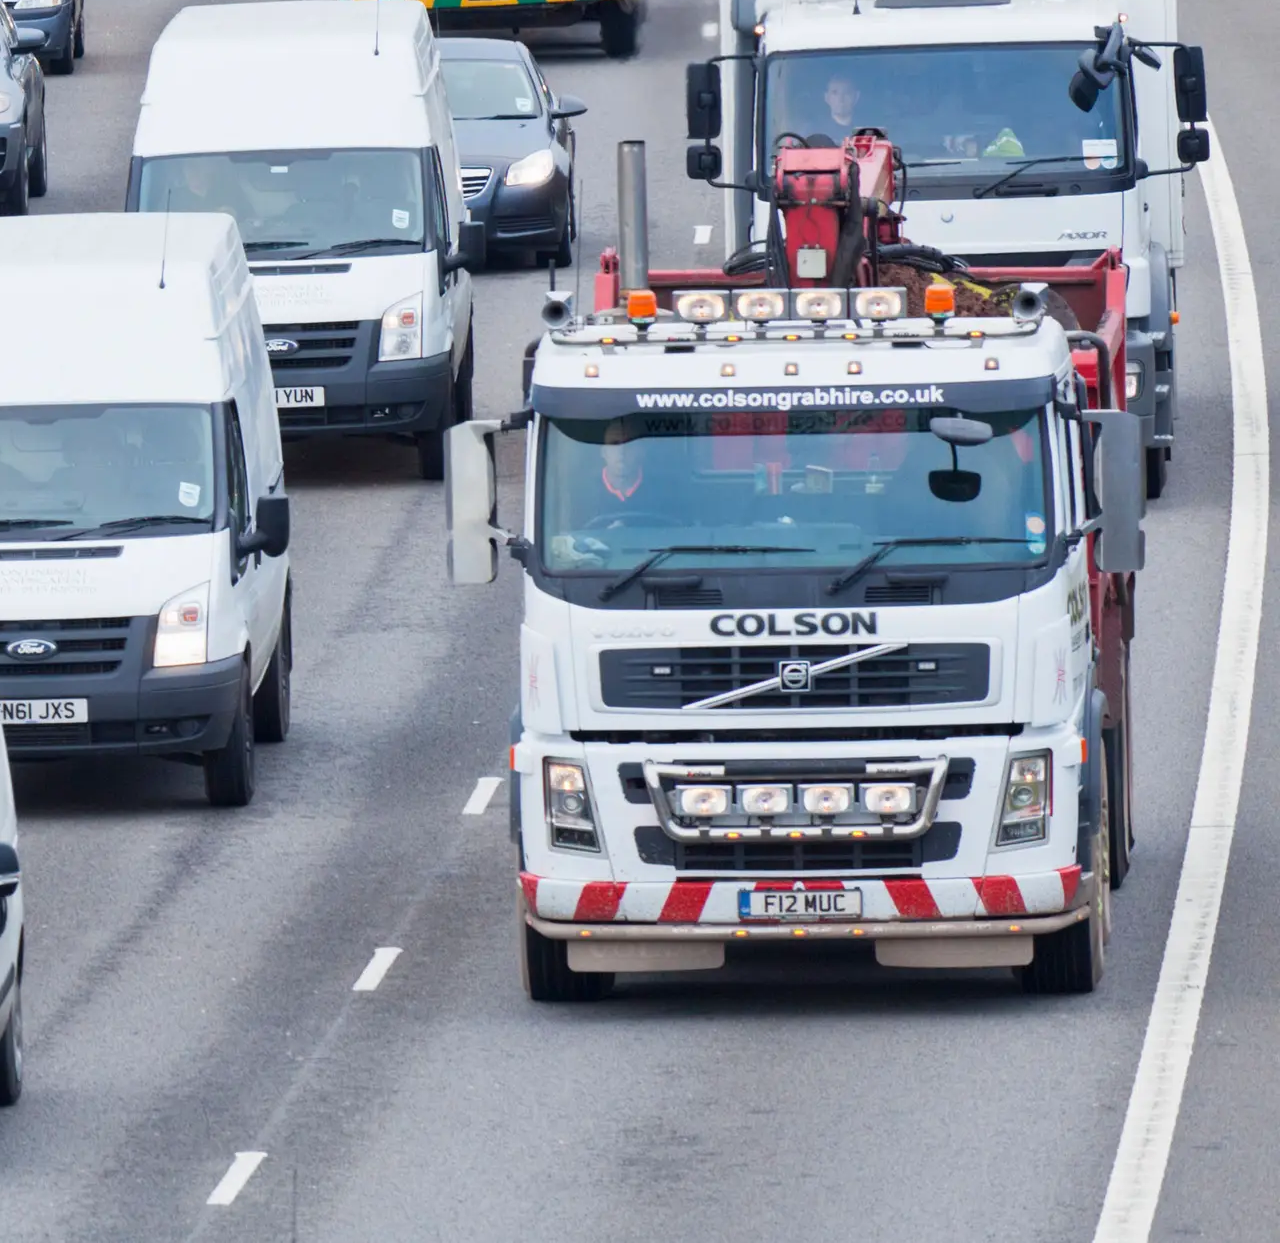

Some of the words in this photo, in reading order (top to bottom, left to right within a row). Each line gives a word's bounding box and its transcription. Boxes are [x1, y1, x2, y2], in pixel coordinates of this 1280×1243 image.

[283, 388, 314, 403] YUN
[636, 385, 945, 411] www.colsongrabhire.co.uk
[709, 612, 878, 637] COLSON
[17, 641, 45, 655] Ford
[38, 701, 76, 720] JXS
[764, 895, 799, 913] F12
[804, 894, 846, 912] MUC
